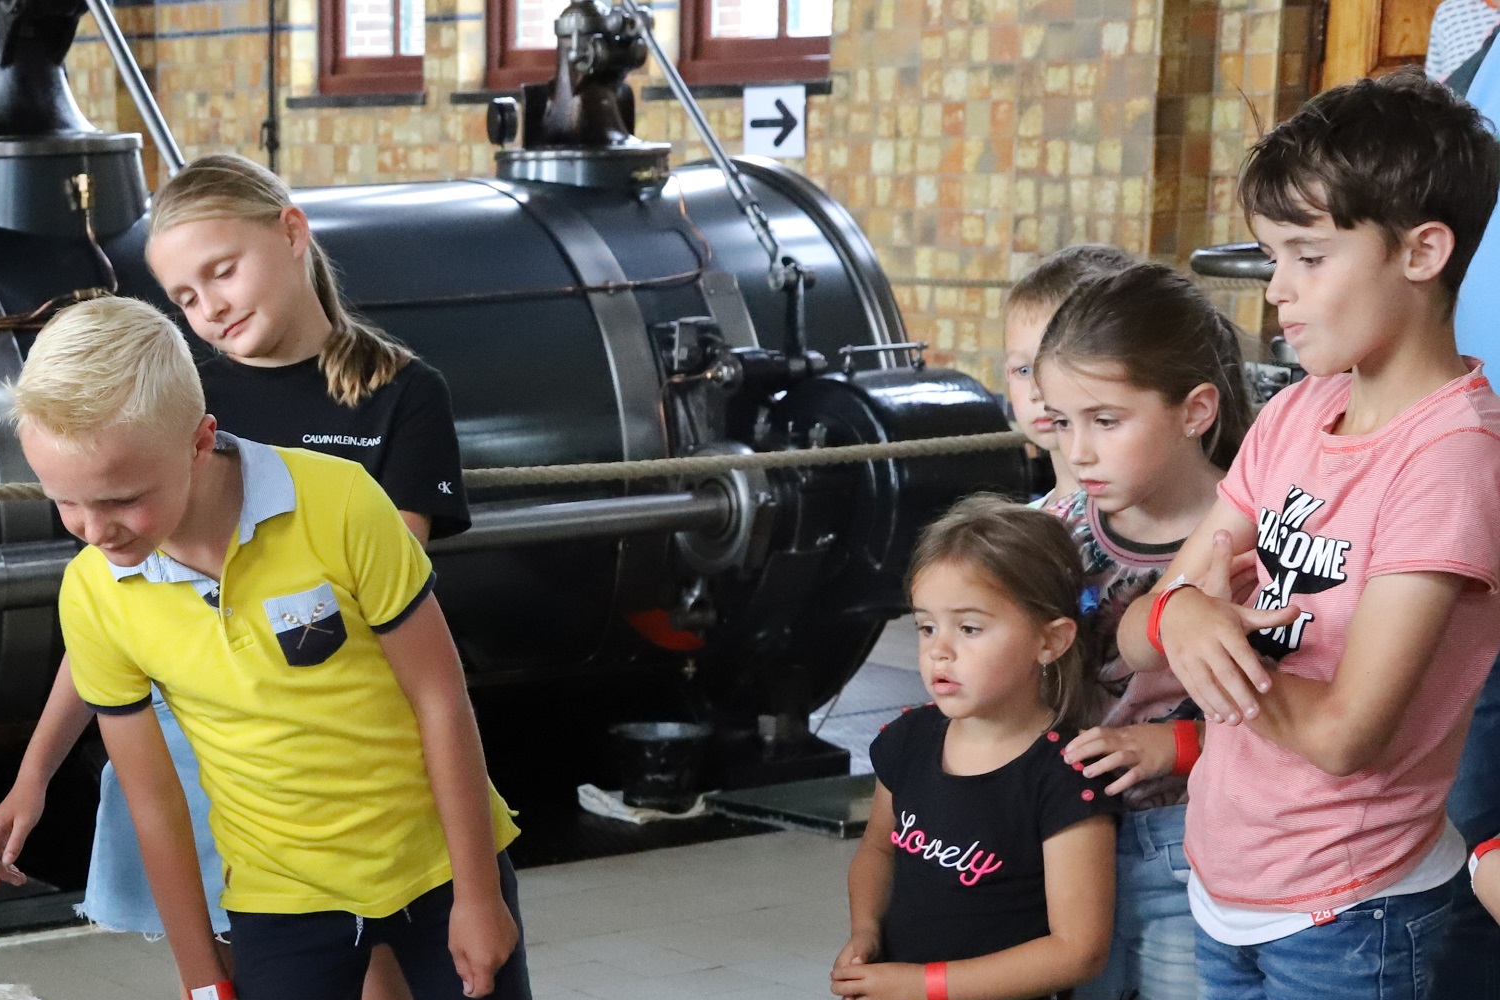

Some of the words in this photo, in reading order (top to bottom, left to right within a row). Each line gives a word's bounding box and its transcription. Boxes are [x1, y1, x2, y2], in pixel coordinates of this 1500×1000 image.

[302, 434, 333, 444] CALVIN
[333, 435, 357, 446] KLEIN
[357, 436, 382, 447] JEANS
[890, 810, 1003, 887] Lovely
